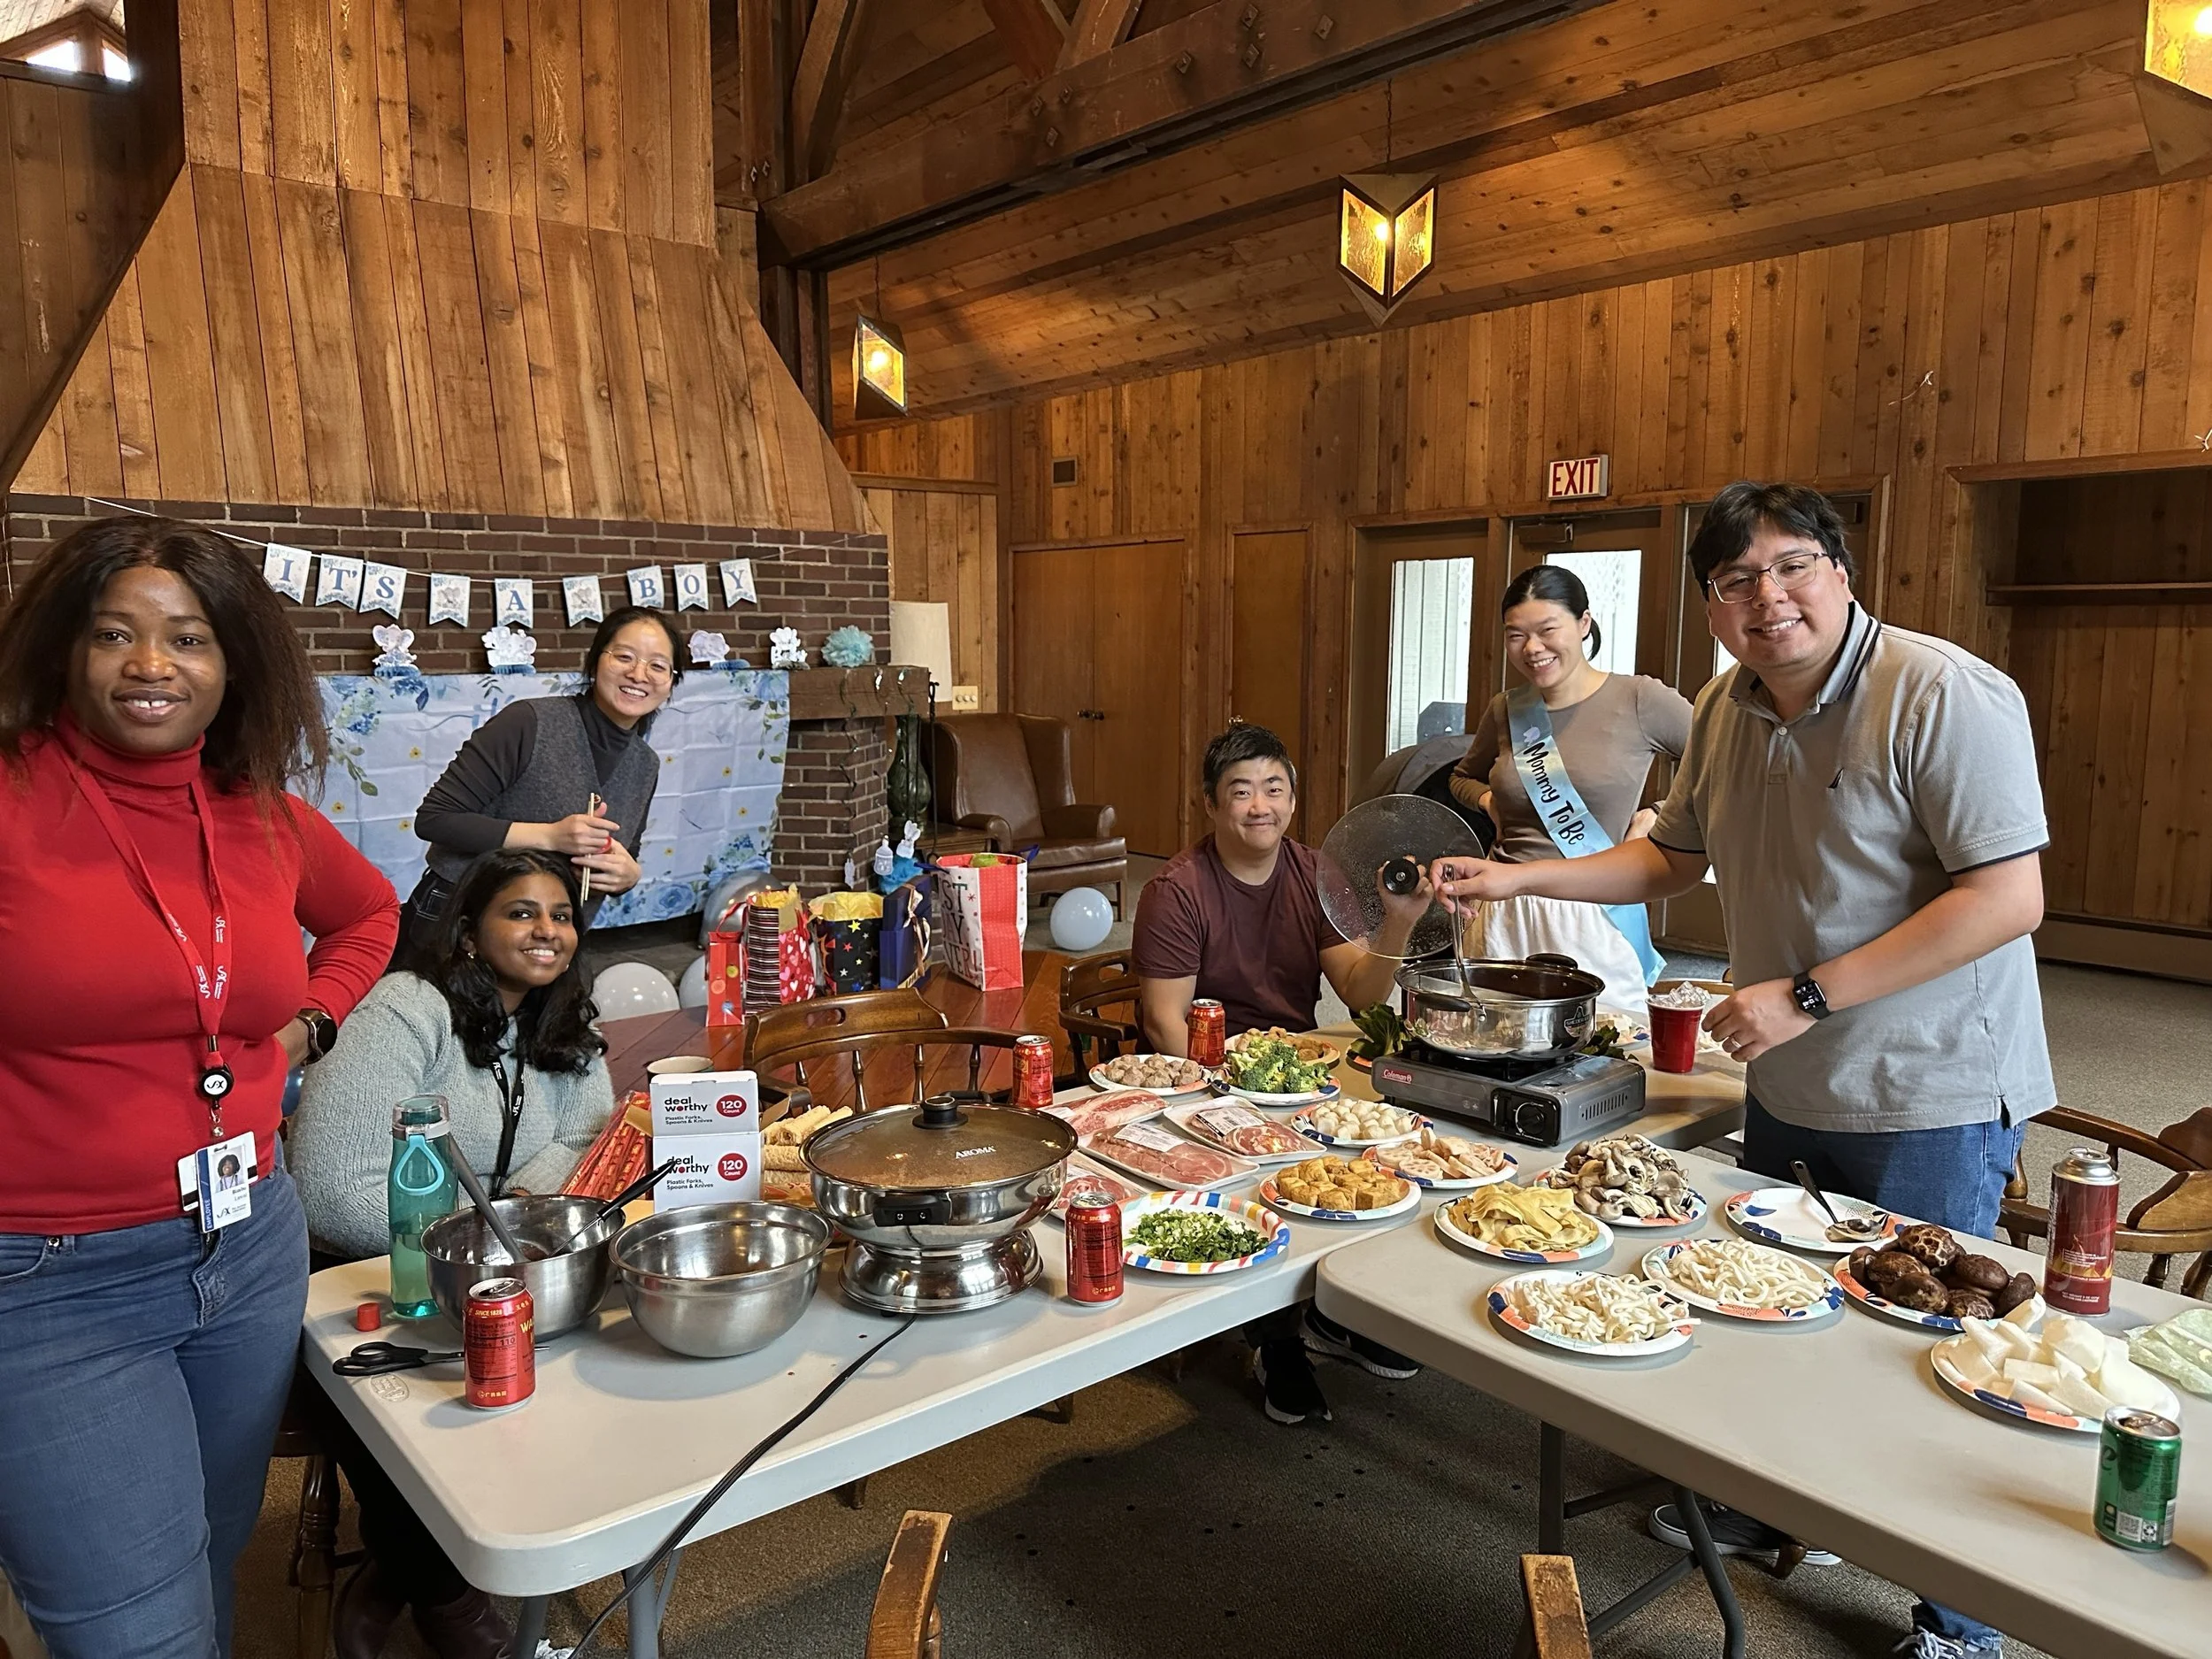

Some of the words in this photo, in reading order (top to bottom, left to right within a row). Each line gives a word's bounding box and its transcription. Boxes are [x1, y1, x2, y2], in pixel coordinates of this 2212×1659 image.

[1552, 458, 1599, 495] EXIT
[279, 558, 396, 599] IT'S
[506, 590, 527, 611] A
[637, 570, 745, 599] BOY
[1523, 741, 1560, 803] Mommy
[1548, 800, 1575, 824] To
[1558, 820, 1585, 845] Be
[941, 879, 968, 913] ST
[942, 940, 978, 979] VER!
[1383, 1069, 1407, 1081] Coleman
[664, 1096, 691, 1105] deal
[664, 1102, 708, 1112] worthy
[721, 1100, 742, 1110] 120
[956, 1145, 996, 1159] AROMA
[667, 1155, 694, 1165] deal
[722, 1159, 743, 1171] 120
[668, 1164, 710, 1174] worthy
[500, 1337, 516, 1346] 110
